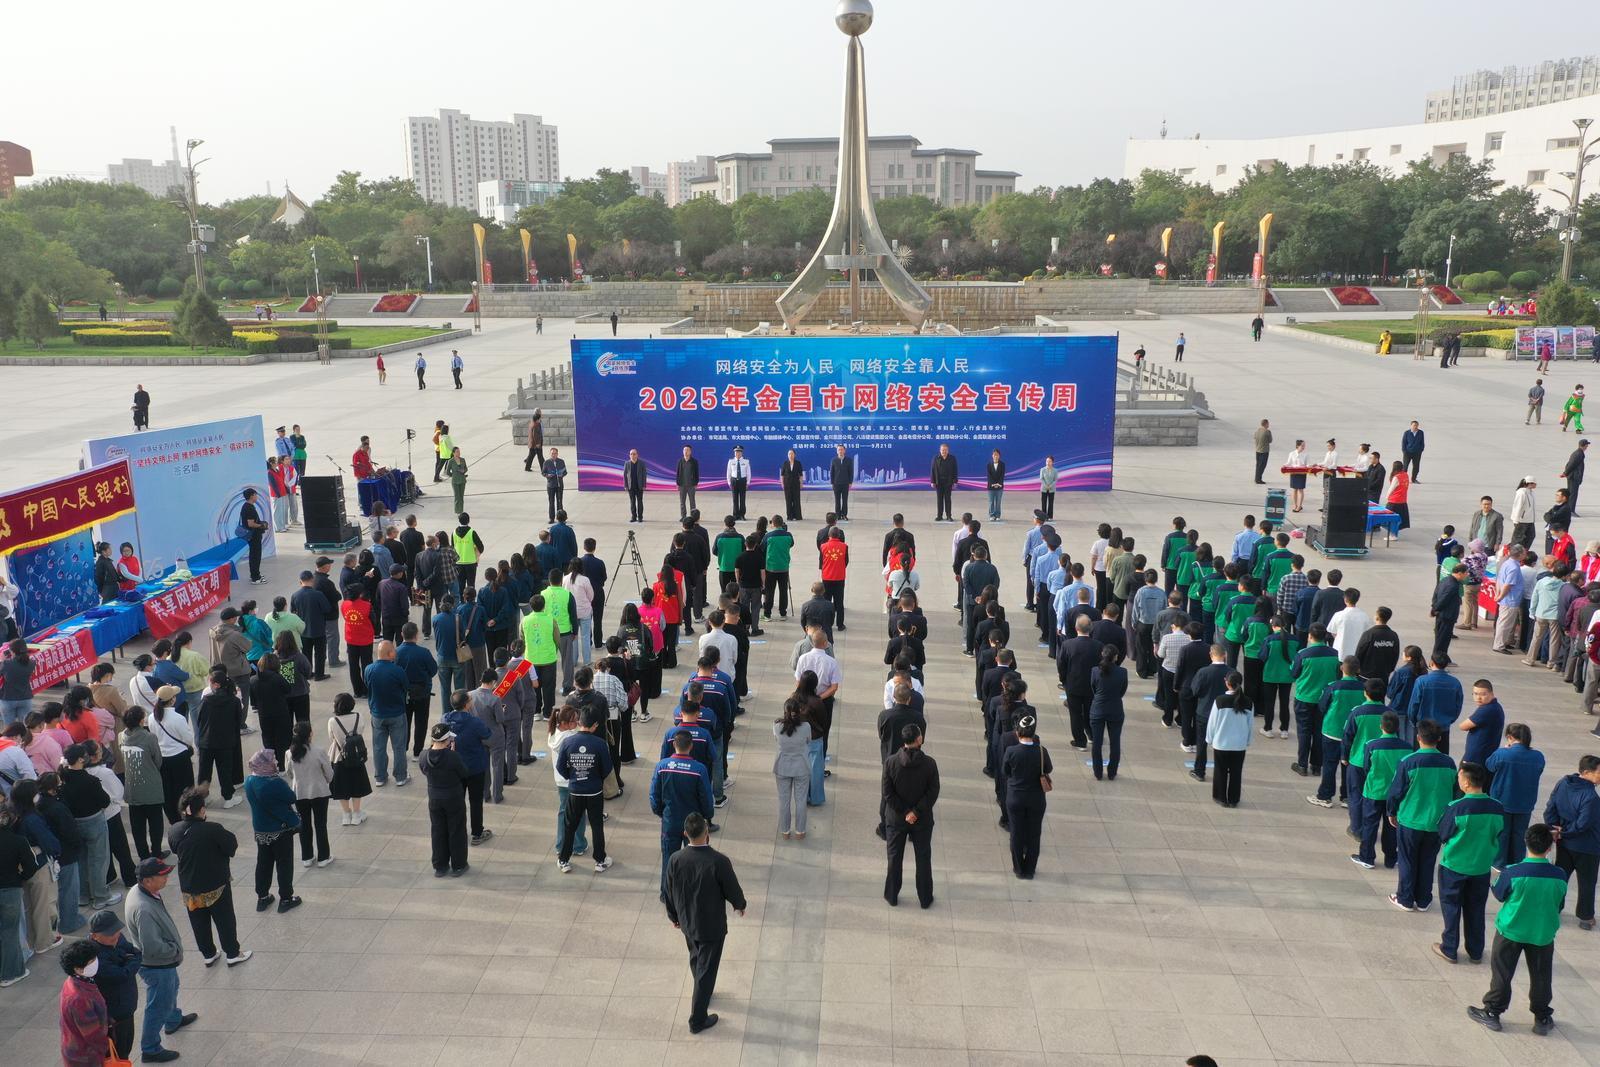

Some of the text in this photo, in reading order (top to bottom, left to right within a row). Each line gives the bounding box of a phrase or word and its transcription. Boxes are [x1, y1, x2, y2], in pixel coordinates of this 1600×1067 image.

[716, 358, 969, 375] 网络安全为人民 网络安全靠人民
[638, 382, 1078, 414] 2025年金昌市网络安全宣传周
[173, 462, 201, 476] 签名墙
[23, 475, 131, 531] 中国人民银行
[151, 570, 220, 618] 共享网络文明
